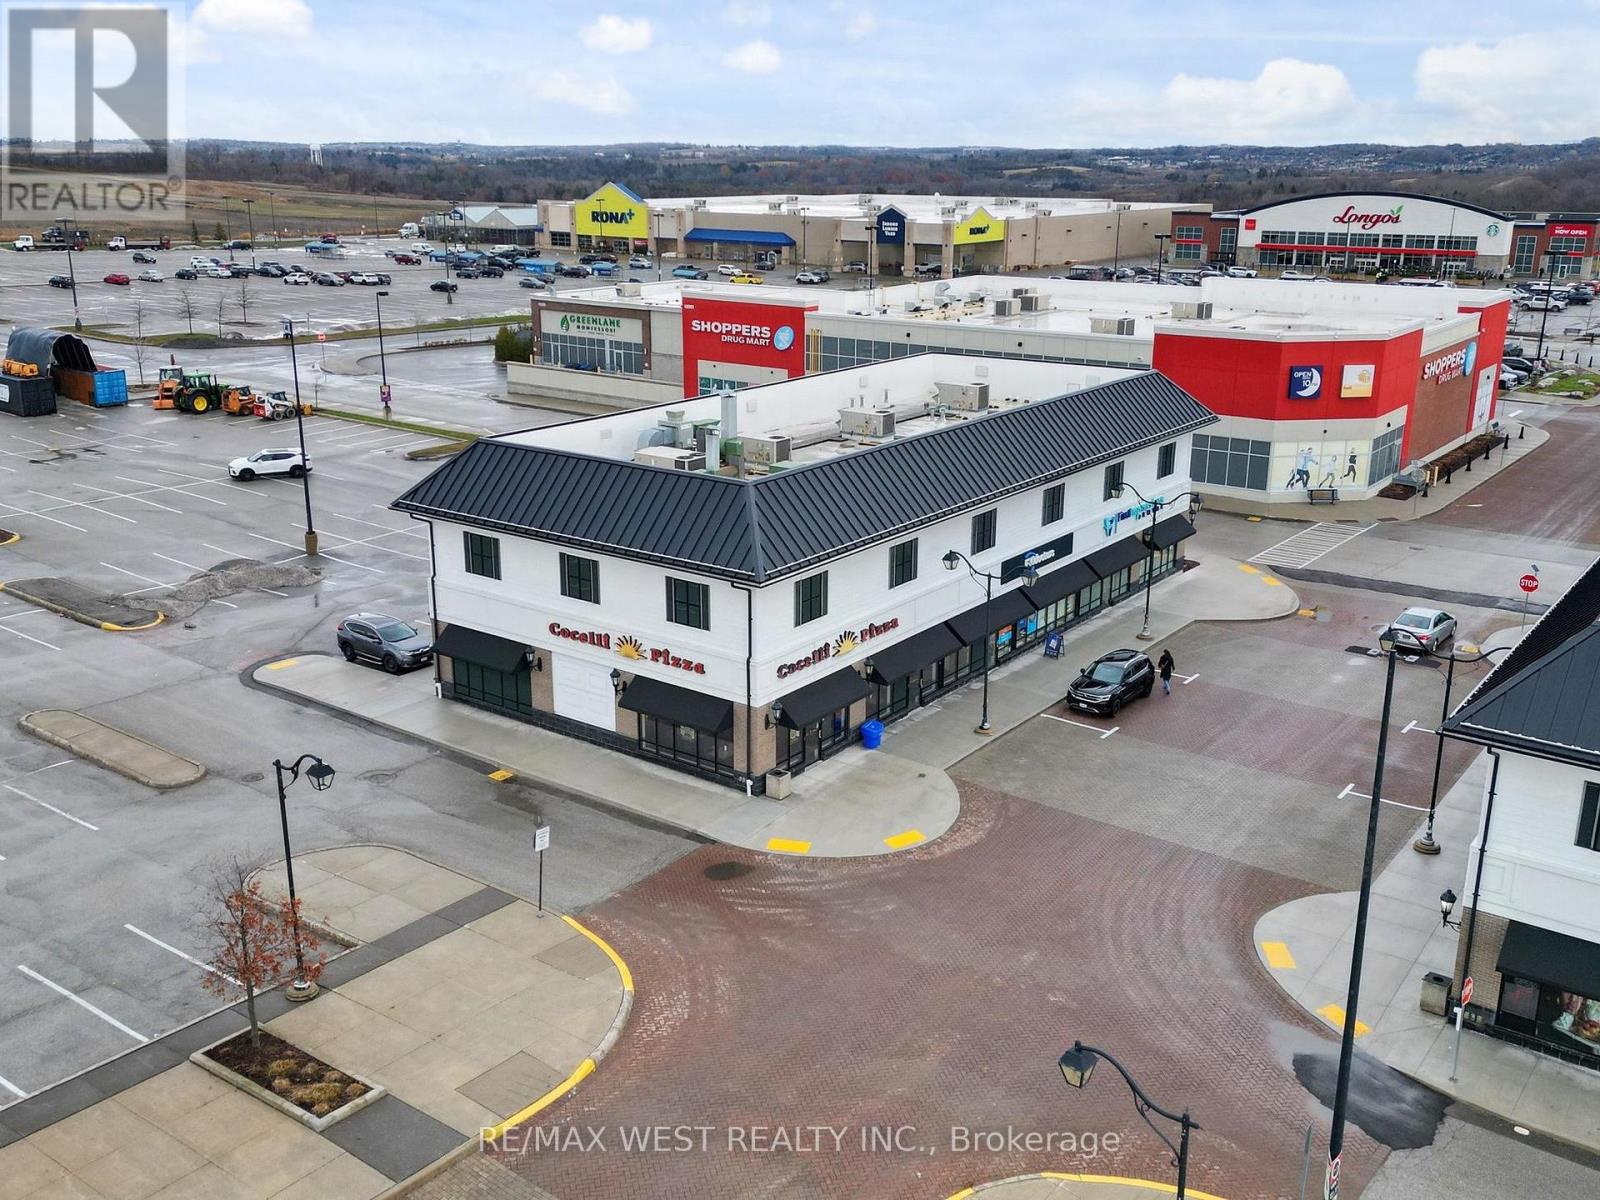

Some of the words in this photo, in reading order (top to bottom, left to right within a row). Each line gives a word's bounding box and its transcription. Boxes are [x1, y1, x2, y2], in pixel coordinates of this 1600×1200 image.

[570, 315, 621, 328] GREENLANE
[691, 319, 771, 338] SHOPPERS
[721, 335, 745, 344] DRUG
[746, 337, 771, 346] MART
[1422, 348, 1466, 380] SHOPPERS
[1520, 579, 1538, 588] STOP
[860, 617, 899, 642] Pizza
[549, 622, 611, 650] Cocelli
[650, 648, 706, 674] Pizza
